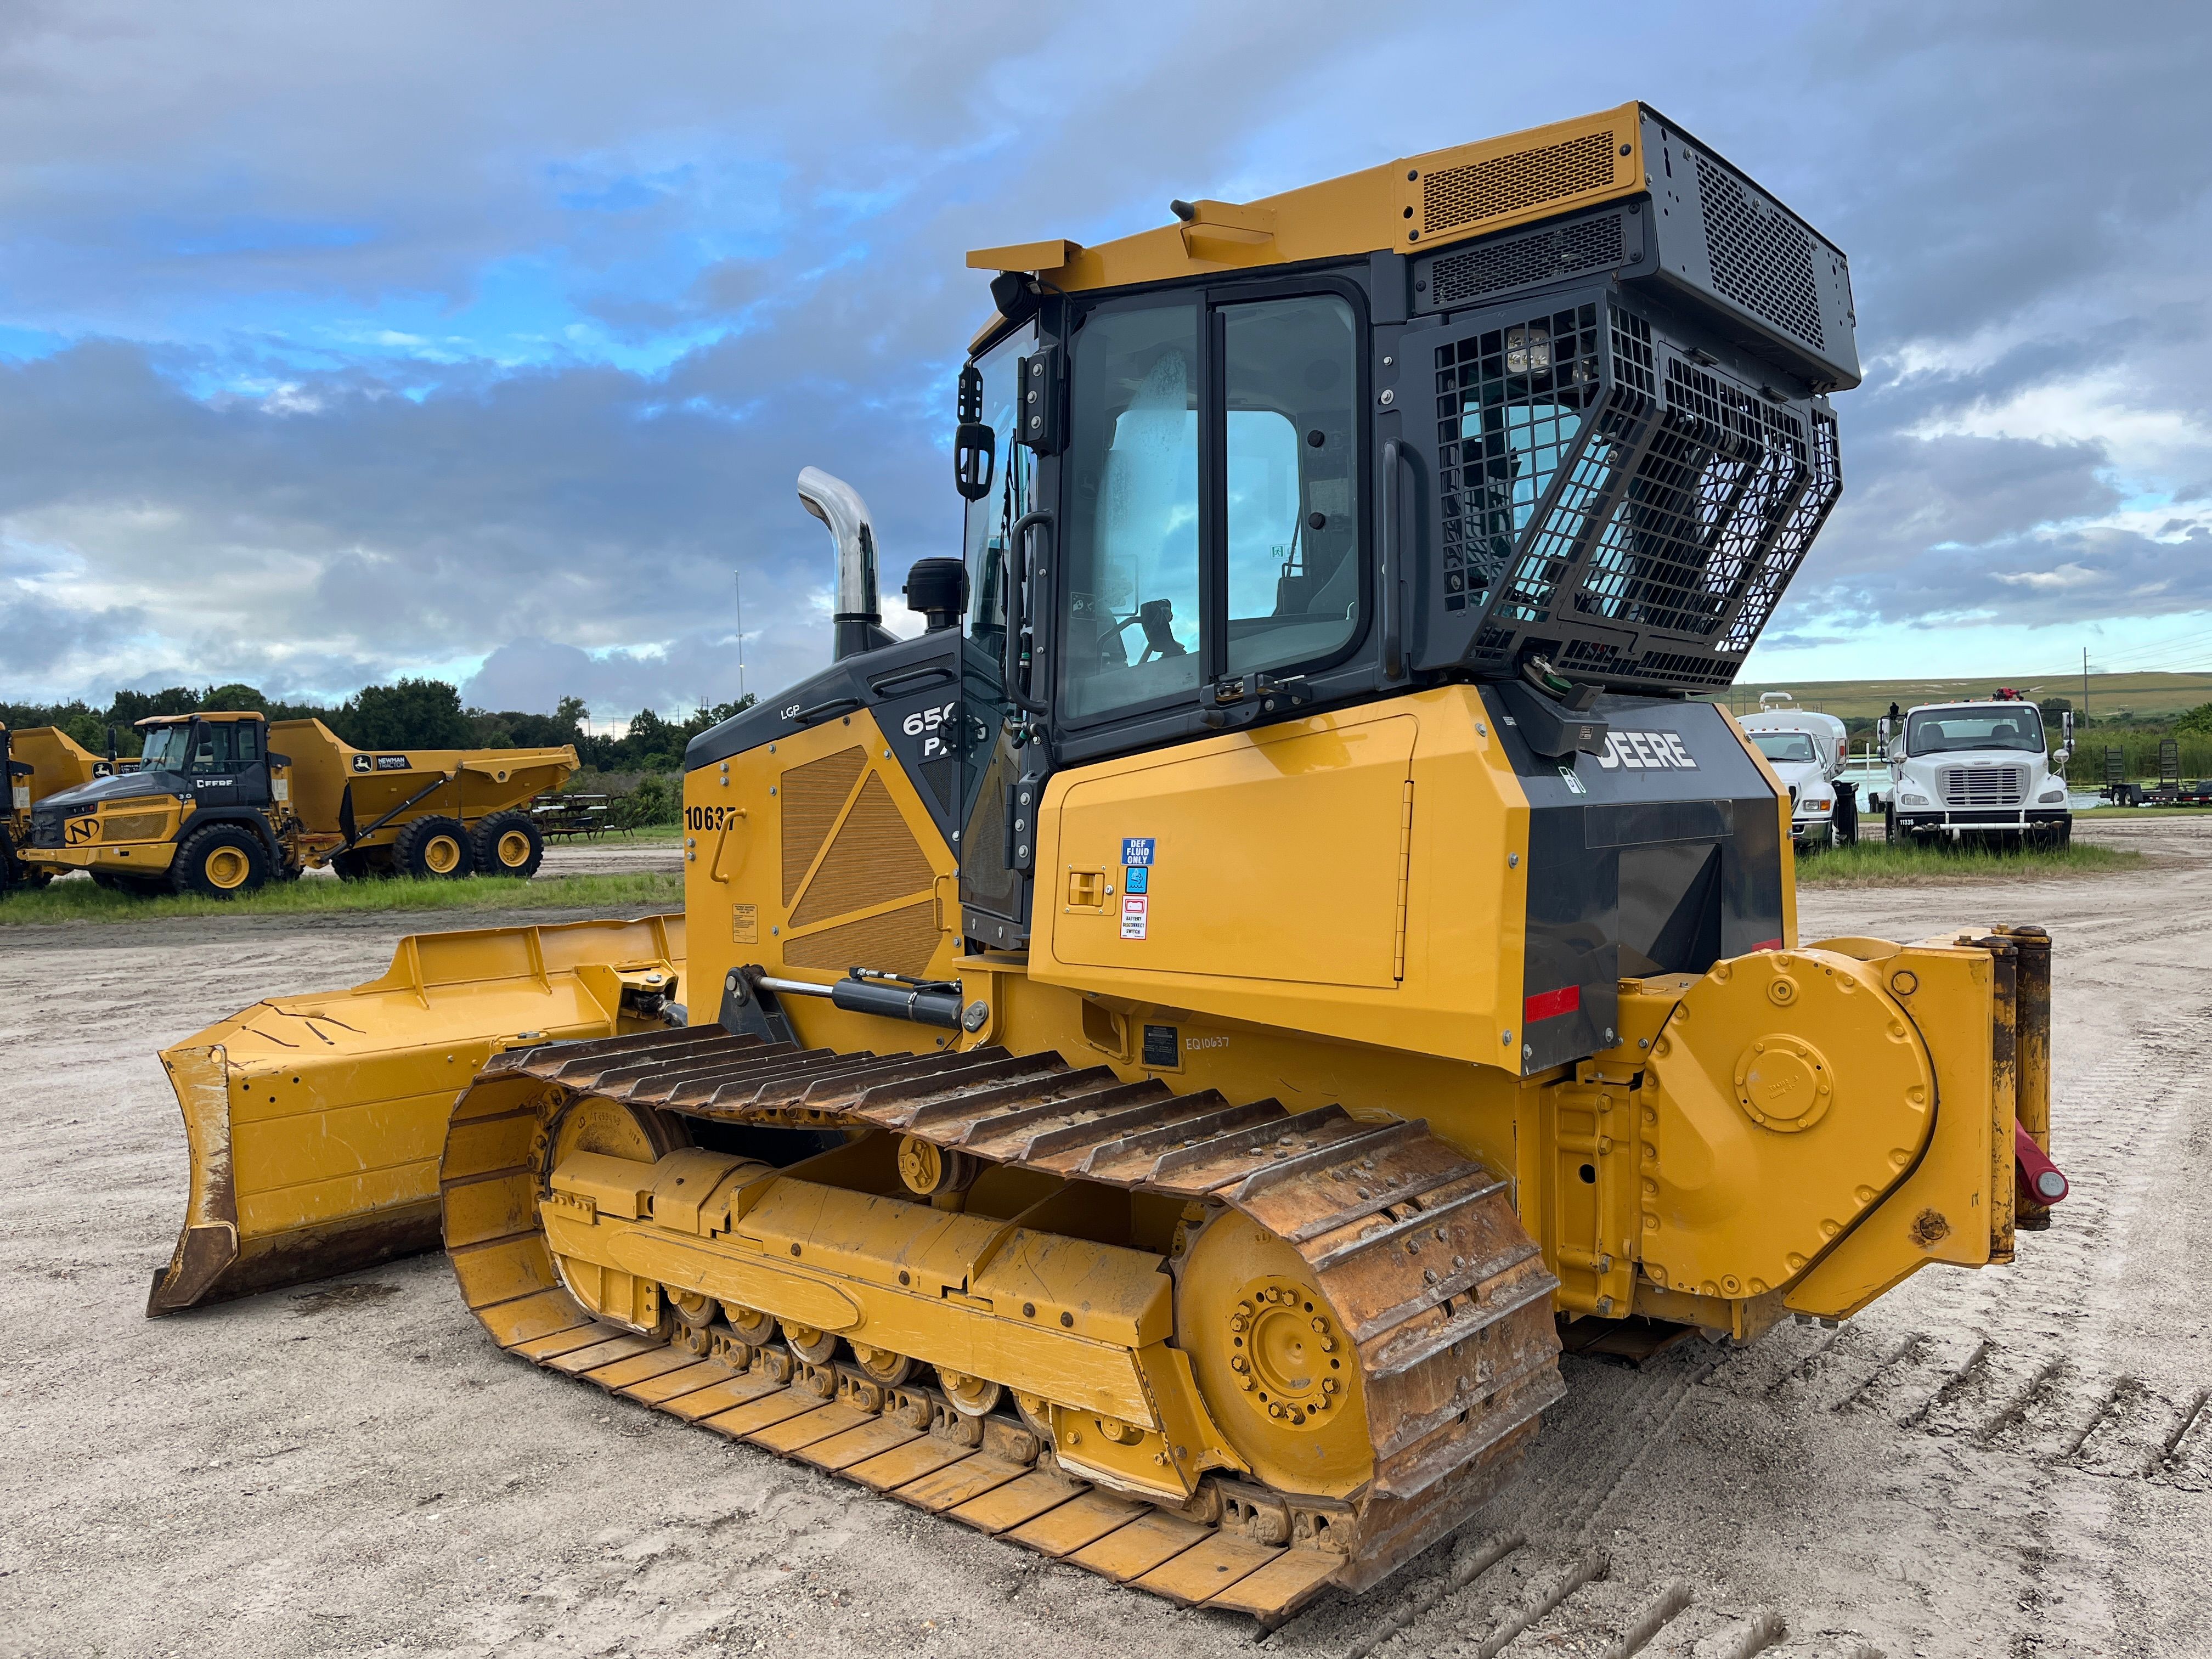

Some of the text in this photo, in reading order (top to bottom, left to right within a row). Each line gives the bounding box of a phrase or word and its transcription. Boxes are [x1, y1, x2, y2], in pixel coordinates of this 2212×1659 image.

[780, 704, 800, 720] LGP
[685, 806, 736, 831] 10637
[1131, 839, 1146, 848] DEF
[1126, 848, 1149, 856] FLUID
[1127, 856, 1148, 864] ONLY
[1186, 1036, 1229, 1050] EQ10637
